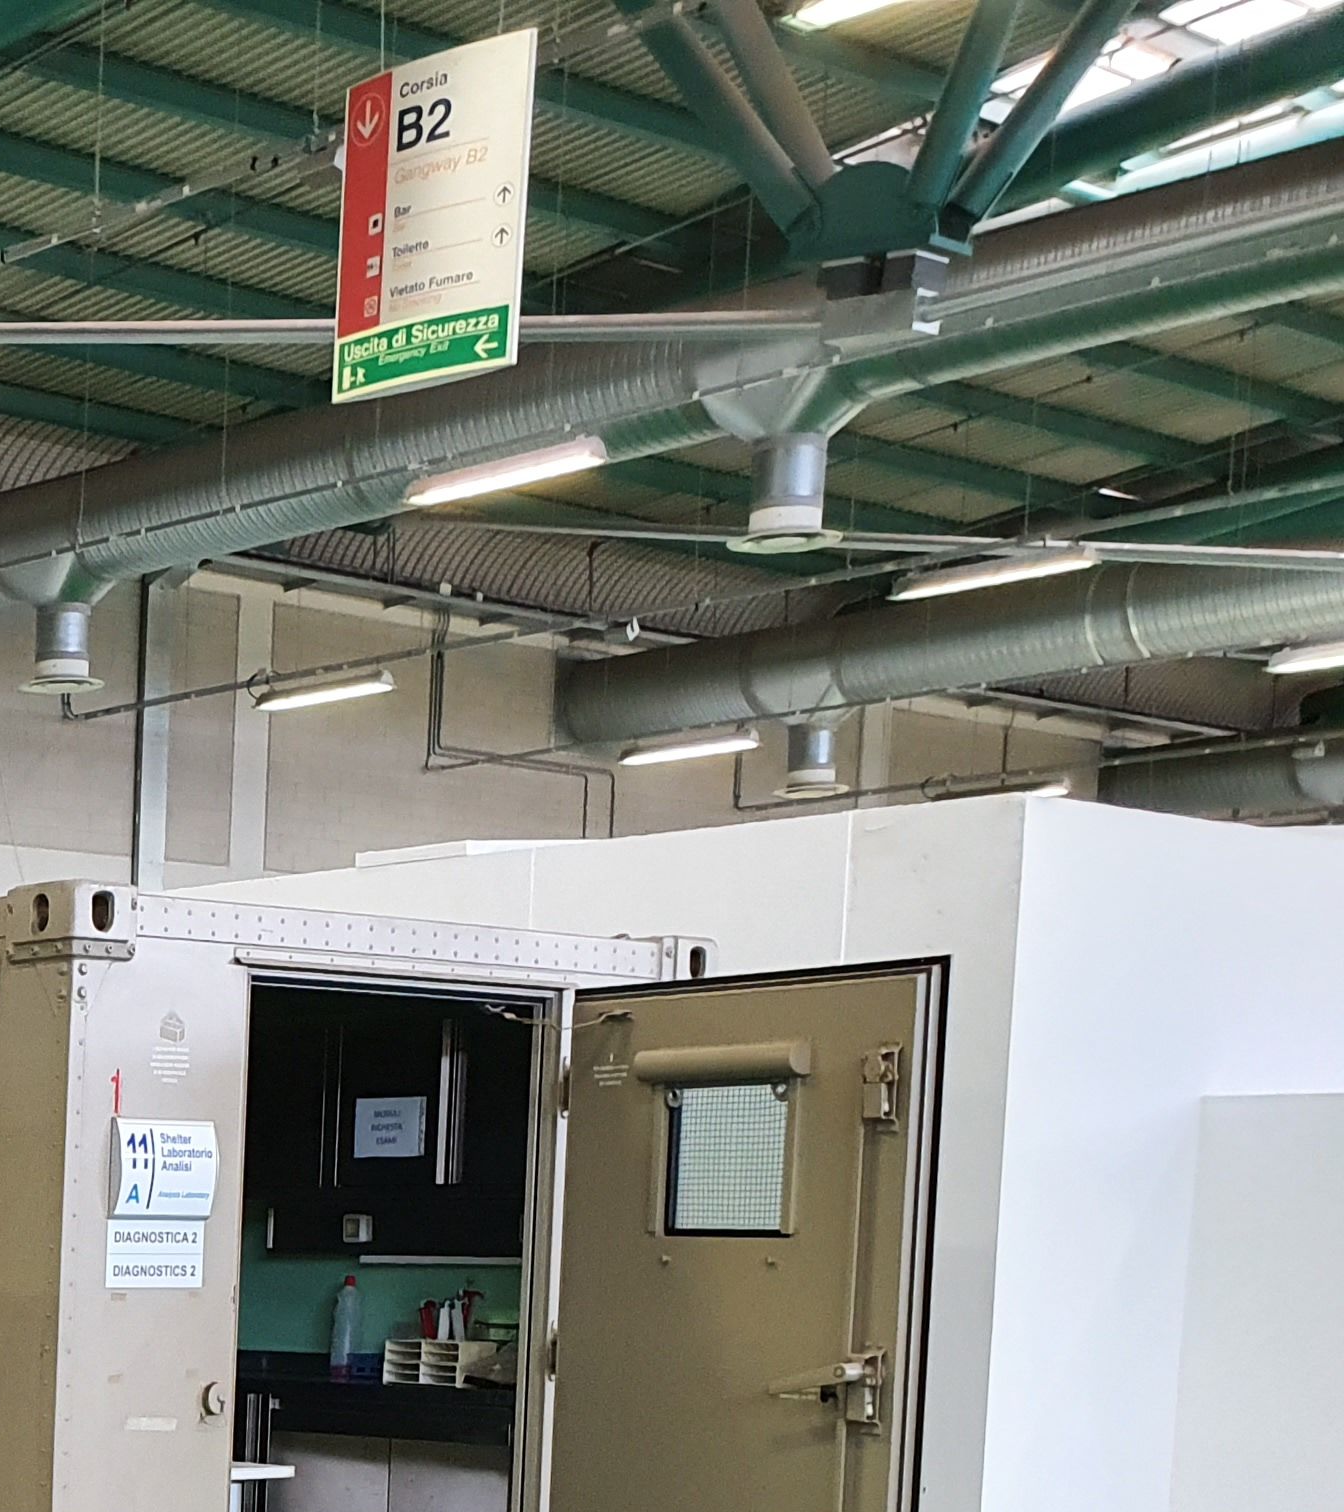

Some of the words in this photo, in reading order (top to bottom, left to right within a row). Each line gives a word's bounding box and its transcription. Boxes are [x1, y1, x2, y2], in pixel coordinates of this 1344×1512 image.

[398, 70, 449, 100] Corsia
[395, 97, 454, 154] B2
[394, 155, 461, 185] Gangway
[466, 146, 489, 166] B2
[393, 204, 412, 219] Bar
[391, 239, 430, 259] Toilette
[388, 279, 426, 299] Vietato
[428, 270, 474, 290] Fumare
[343, 336, 388, 362] Uscita
[392, 330, 407, 348] di
[410, 313, 500, 344] Sicurezza
[378, 346, 427, 366] Emergency
[429, 339, 450, 355] Exit
[110, 1068, 123, 1114] 1
[159, 1132, 192, 1144] Shelter
[125, 1132, 150, 1170] 11
[160, 1146, 213, 1159] Laboratorio
[160, 1160, 193, 1172] Analisi
[125, 1183, 141, 1204] A
[113, 1230, 189, 1244] DIAGNOSTICA
[190, 1231, 198, 1244] 2
[112, 1264, 188, 1278] DIAGNOSTICS
[189, 1264, 197, 1277] 2
